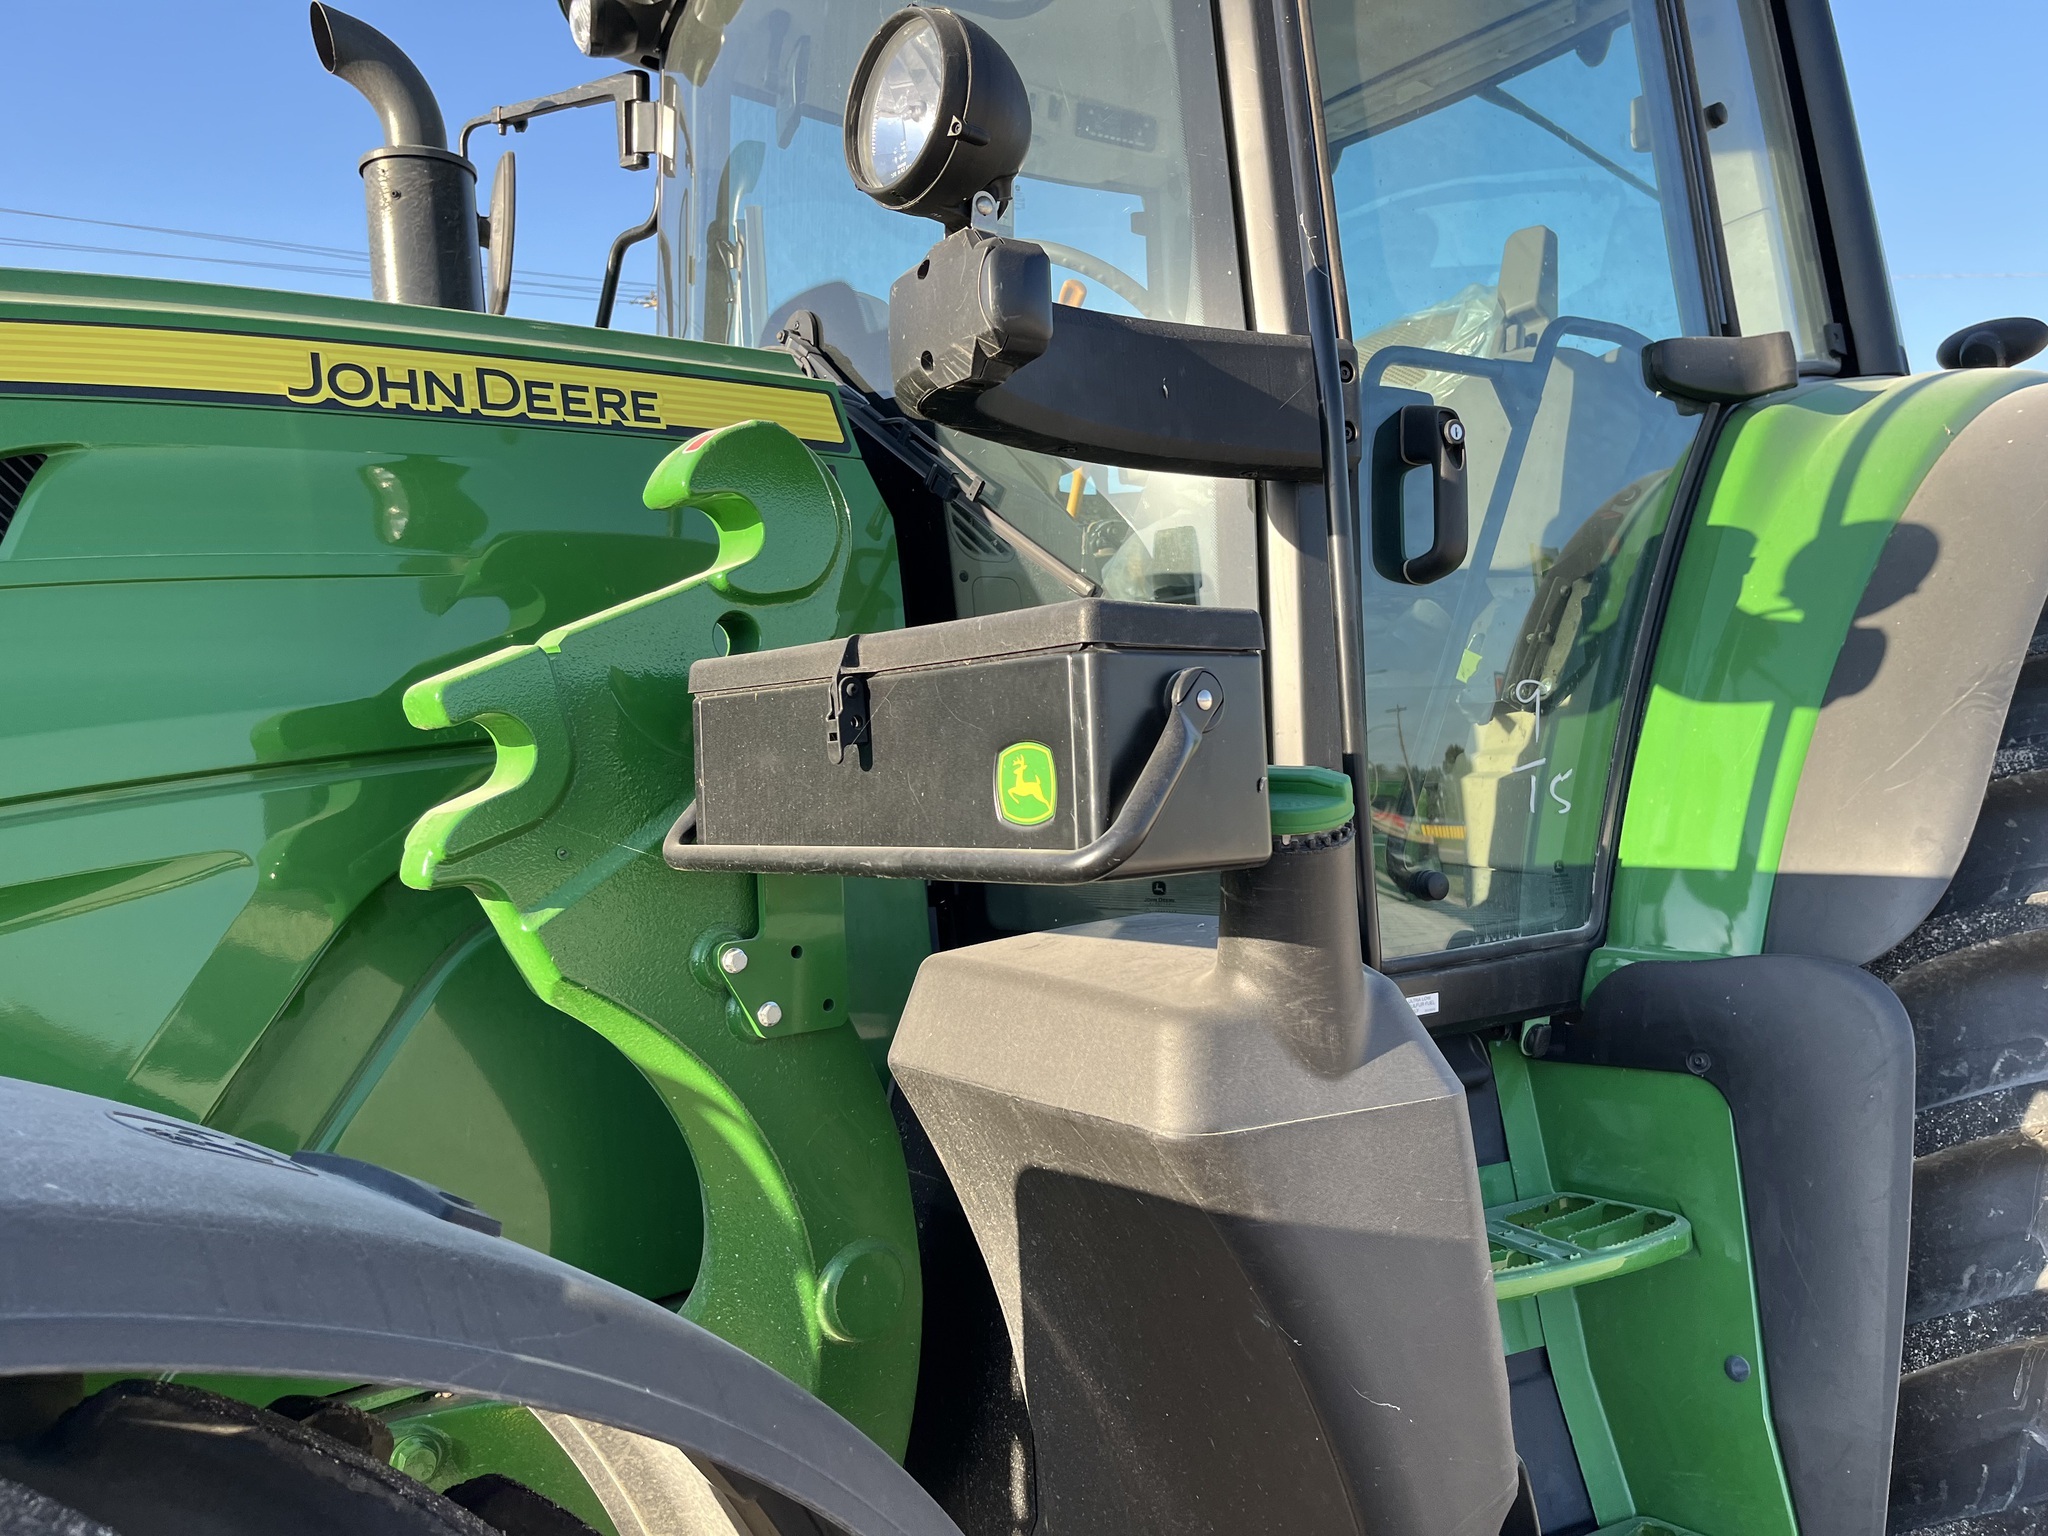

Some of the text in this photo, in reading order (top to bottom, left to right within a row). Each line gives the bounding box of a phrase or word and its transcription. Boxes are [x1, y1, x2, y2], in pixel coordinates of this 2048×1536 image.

[287, 351, 662, 424] JOHN DEERE
[1515, 679, 1546, 743] 9
